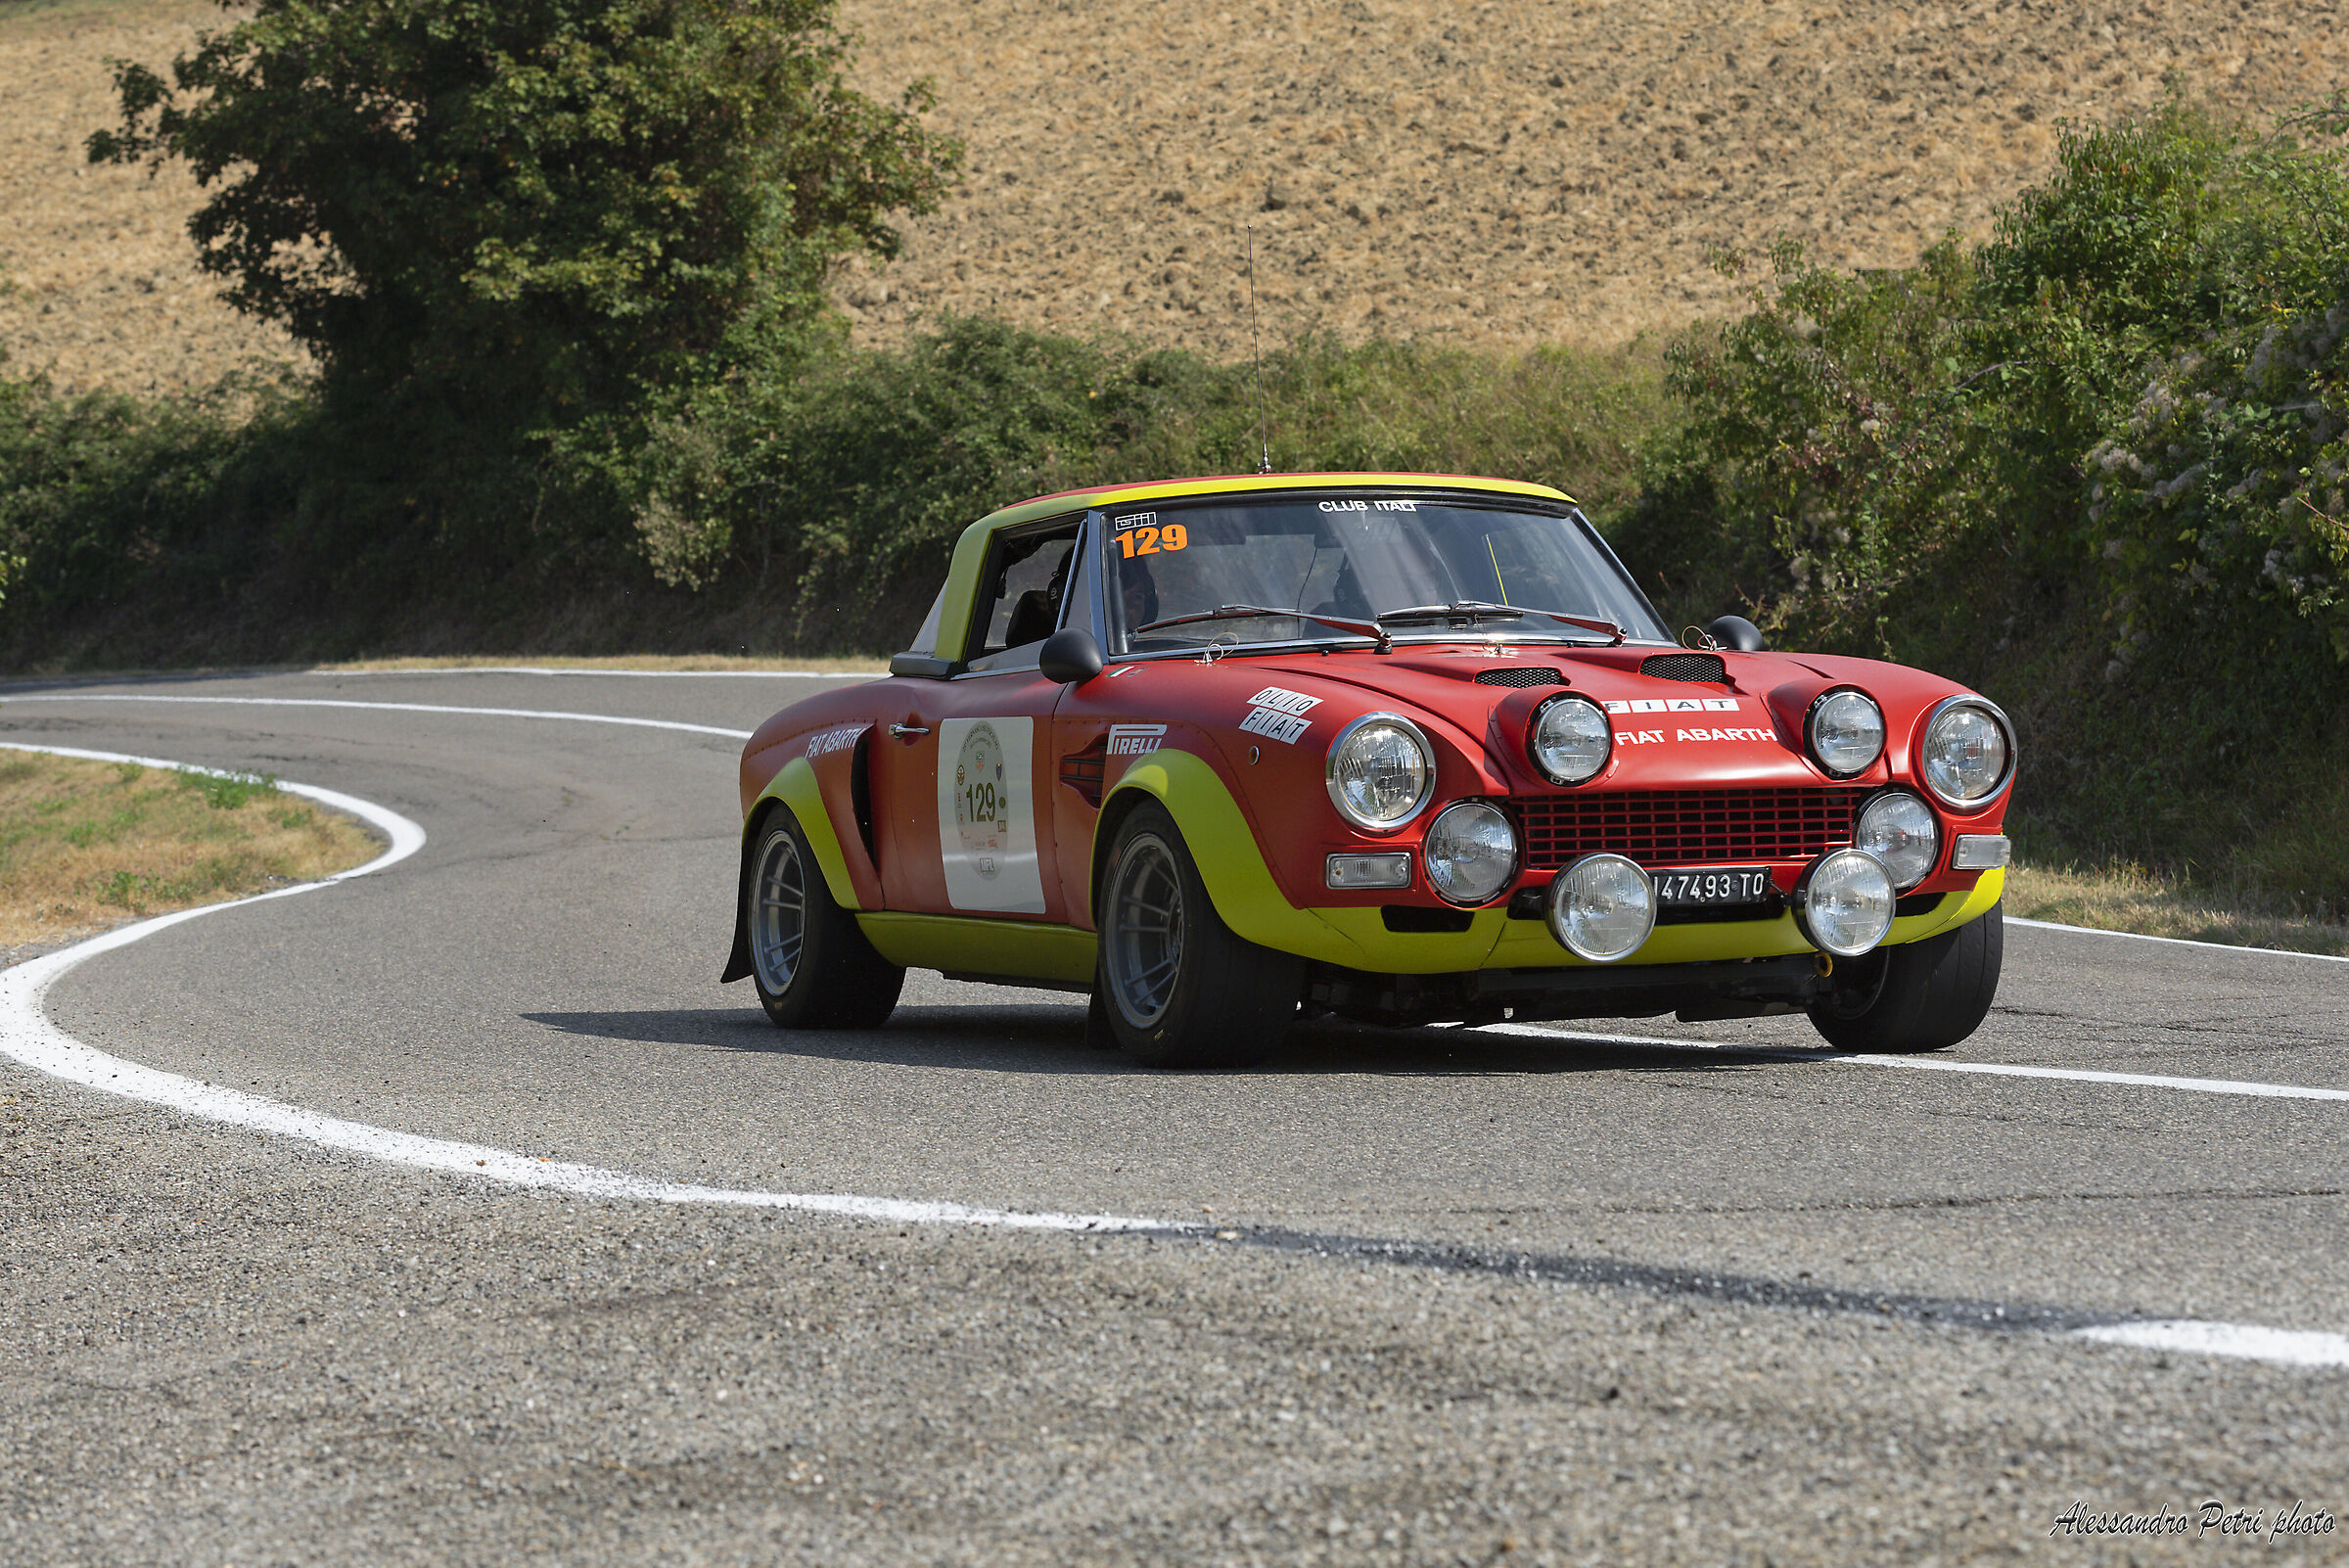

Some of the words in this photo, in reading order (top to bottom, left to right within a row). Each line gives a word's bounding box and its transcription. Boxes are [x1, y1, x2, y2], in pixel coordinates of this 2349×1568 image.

[1317, 499, 1368, 513] CLUB
[1115, 524, 1188, 559] 129
[1254, 689, 1314, 713] OLIO
[1604, 700, 1731, 712] FIAT
[1244, 711, 1306, 739] FIAT
[1614, 729, 1666, 746] FIAT
[1677, 727, 1778, 743] ABARTH
[804, 733, 828, 760] FIAT
[821, 727, 867, 755] ABARTH
[1106, 723, 1168, 755] PIRELLI
[966, 782, 996, 823] 129
[1739, 872, 1765, 898] TO
